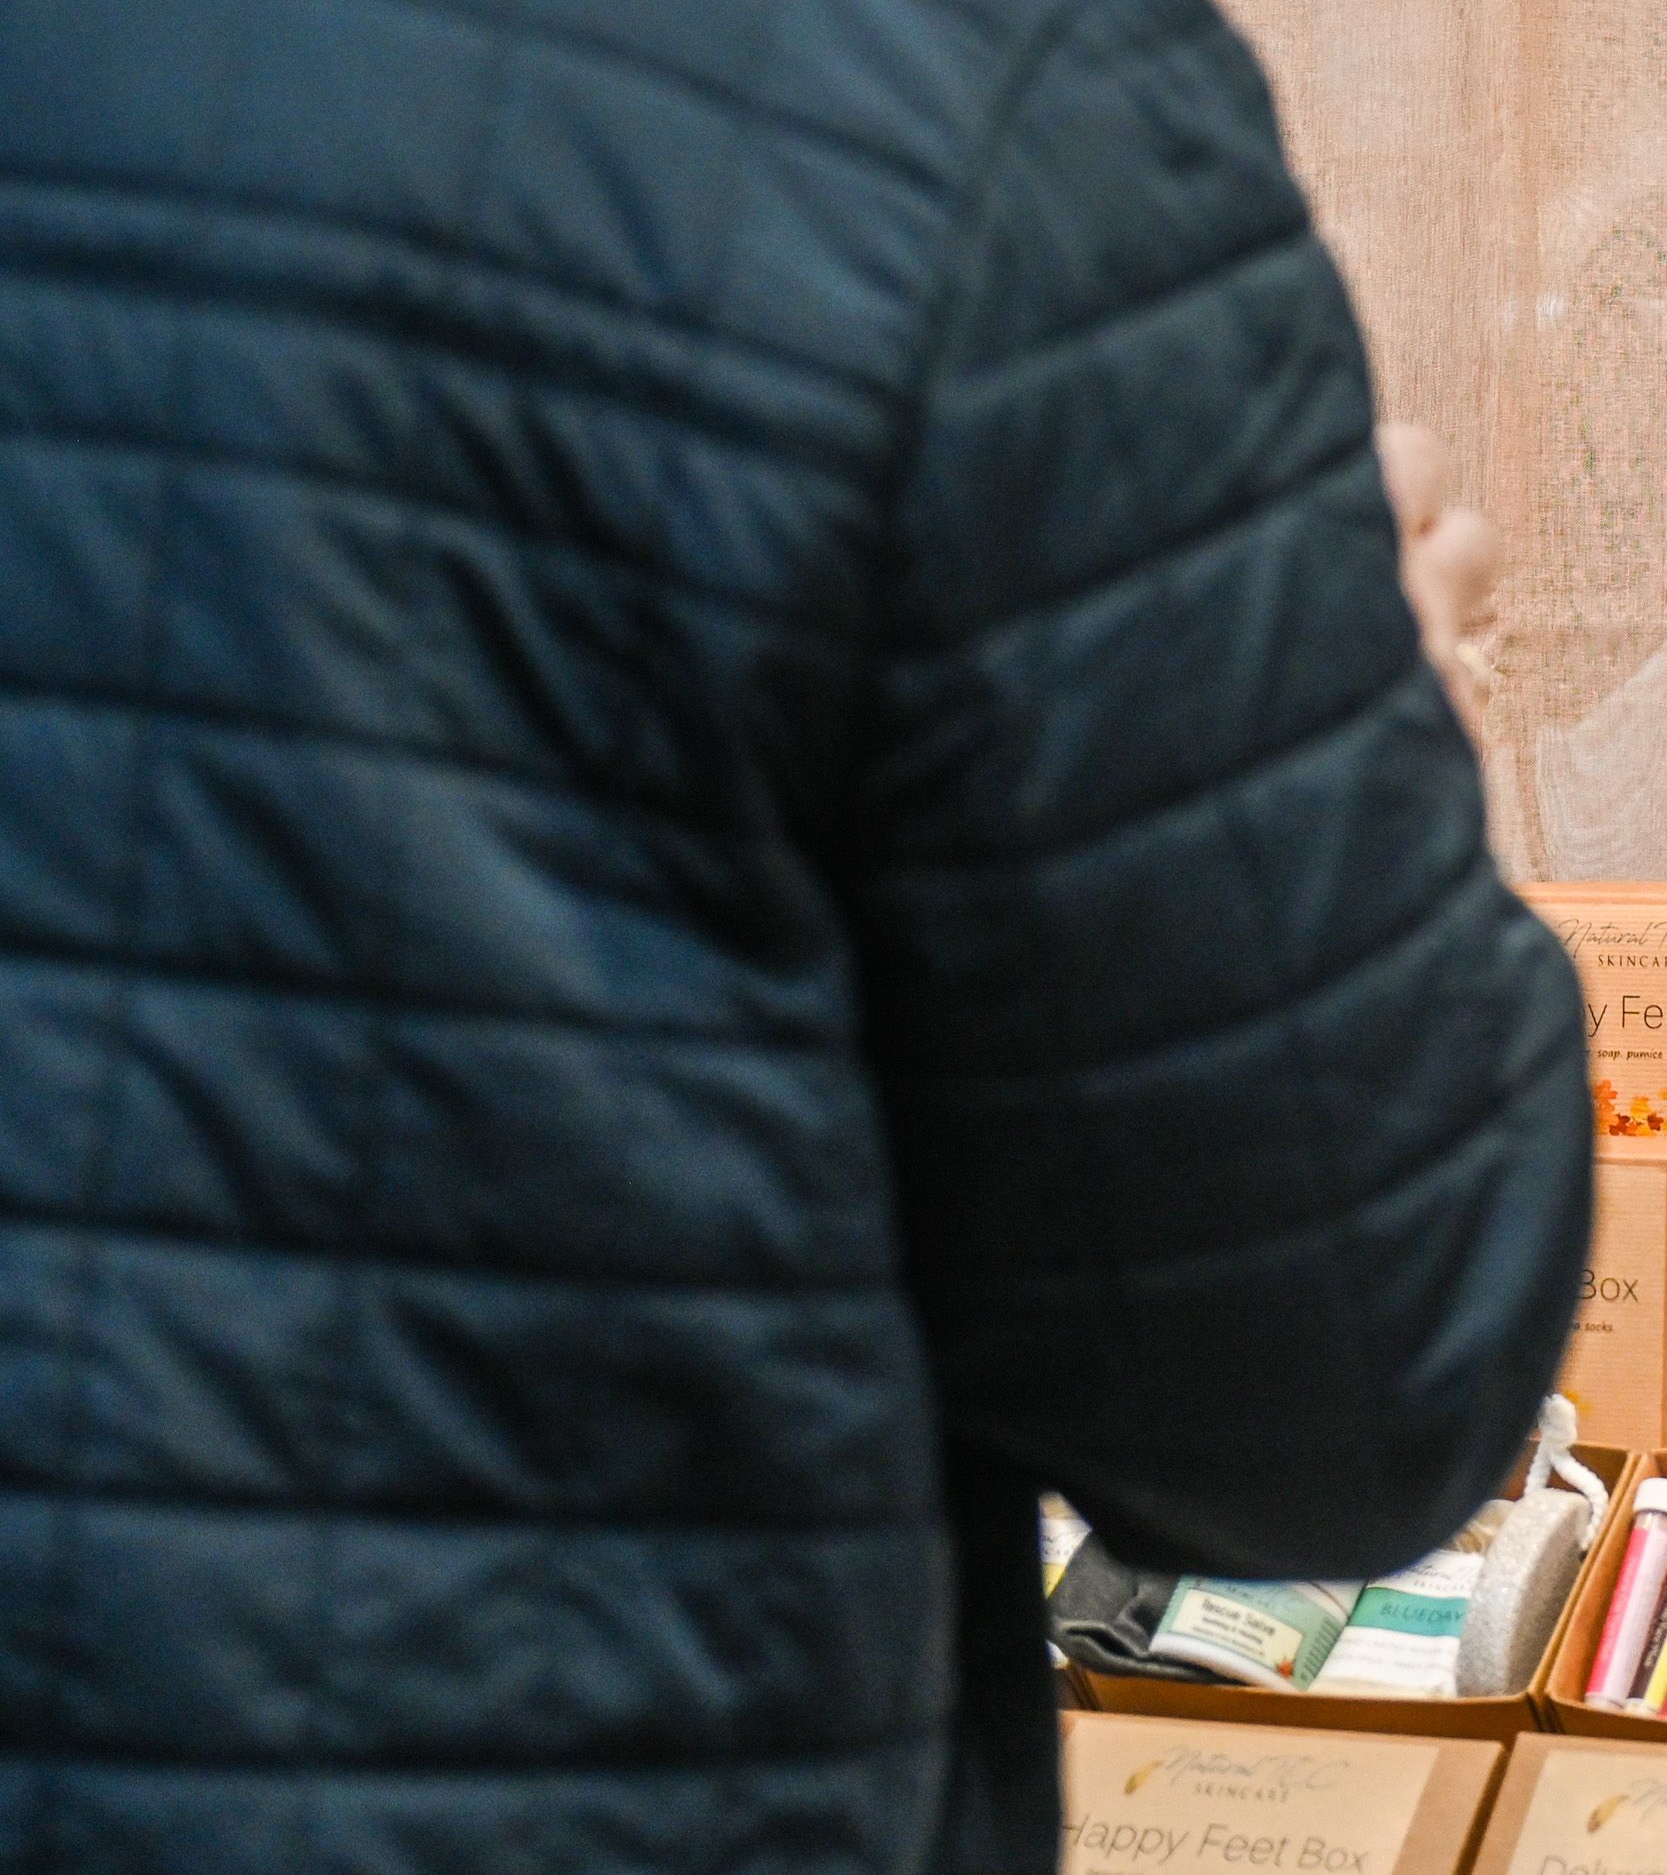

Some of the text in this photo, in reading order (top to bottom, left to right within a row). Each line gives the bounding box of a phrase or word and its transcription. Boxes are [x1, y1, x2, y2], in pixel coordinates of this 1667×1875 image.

[1557, 918, 1653, 959] Natural
[1627, 1049, 1663, 1060] pumice
[1579, 1269, 1640, 1303] Box
[1063, 1812, 1369, 1874] Happy Feet Box
